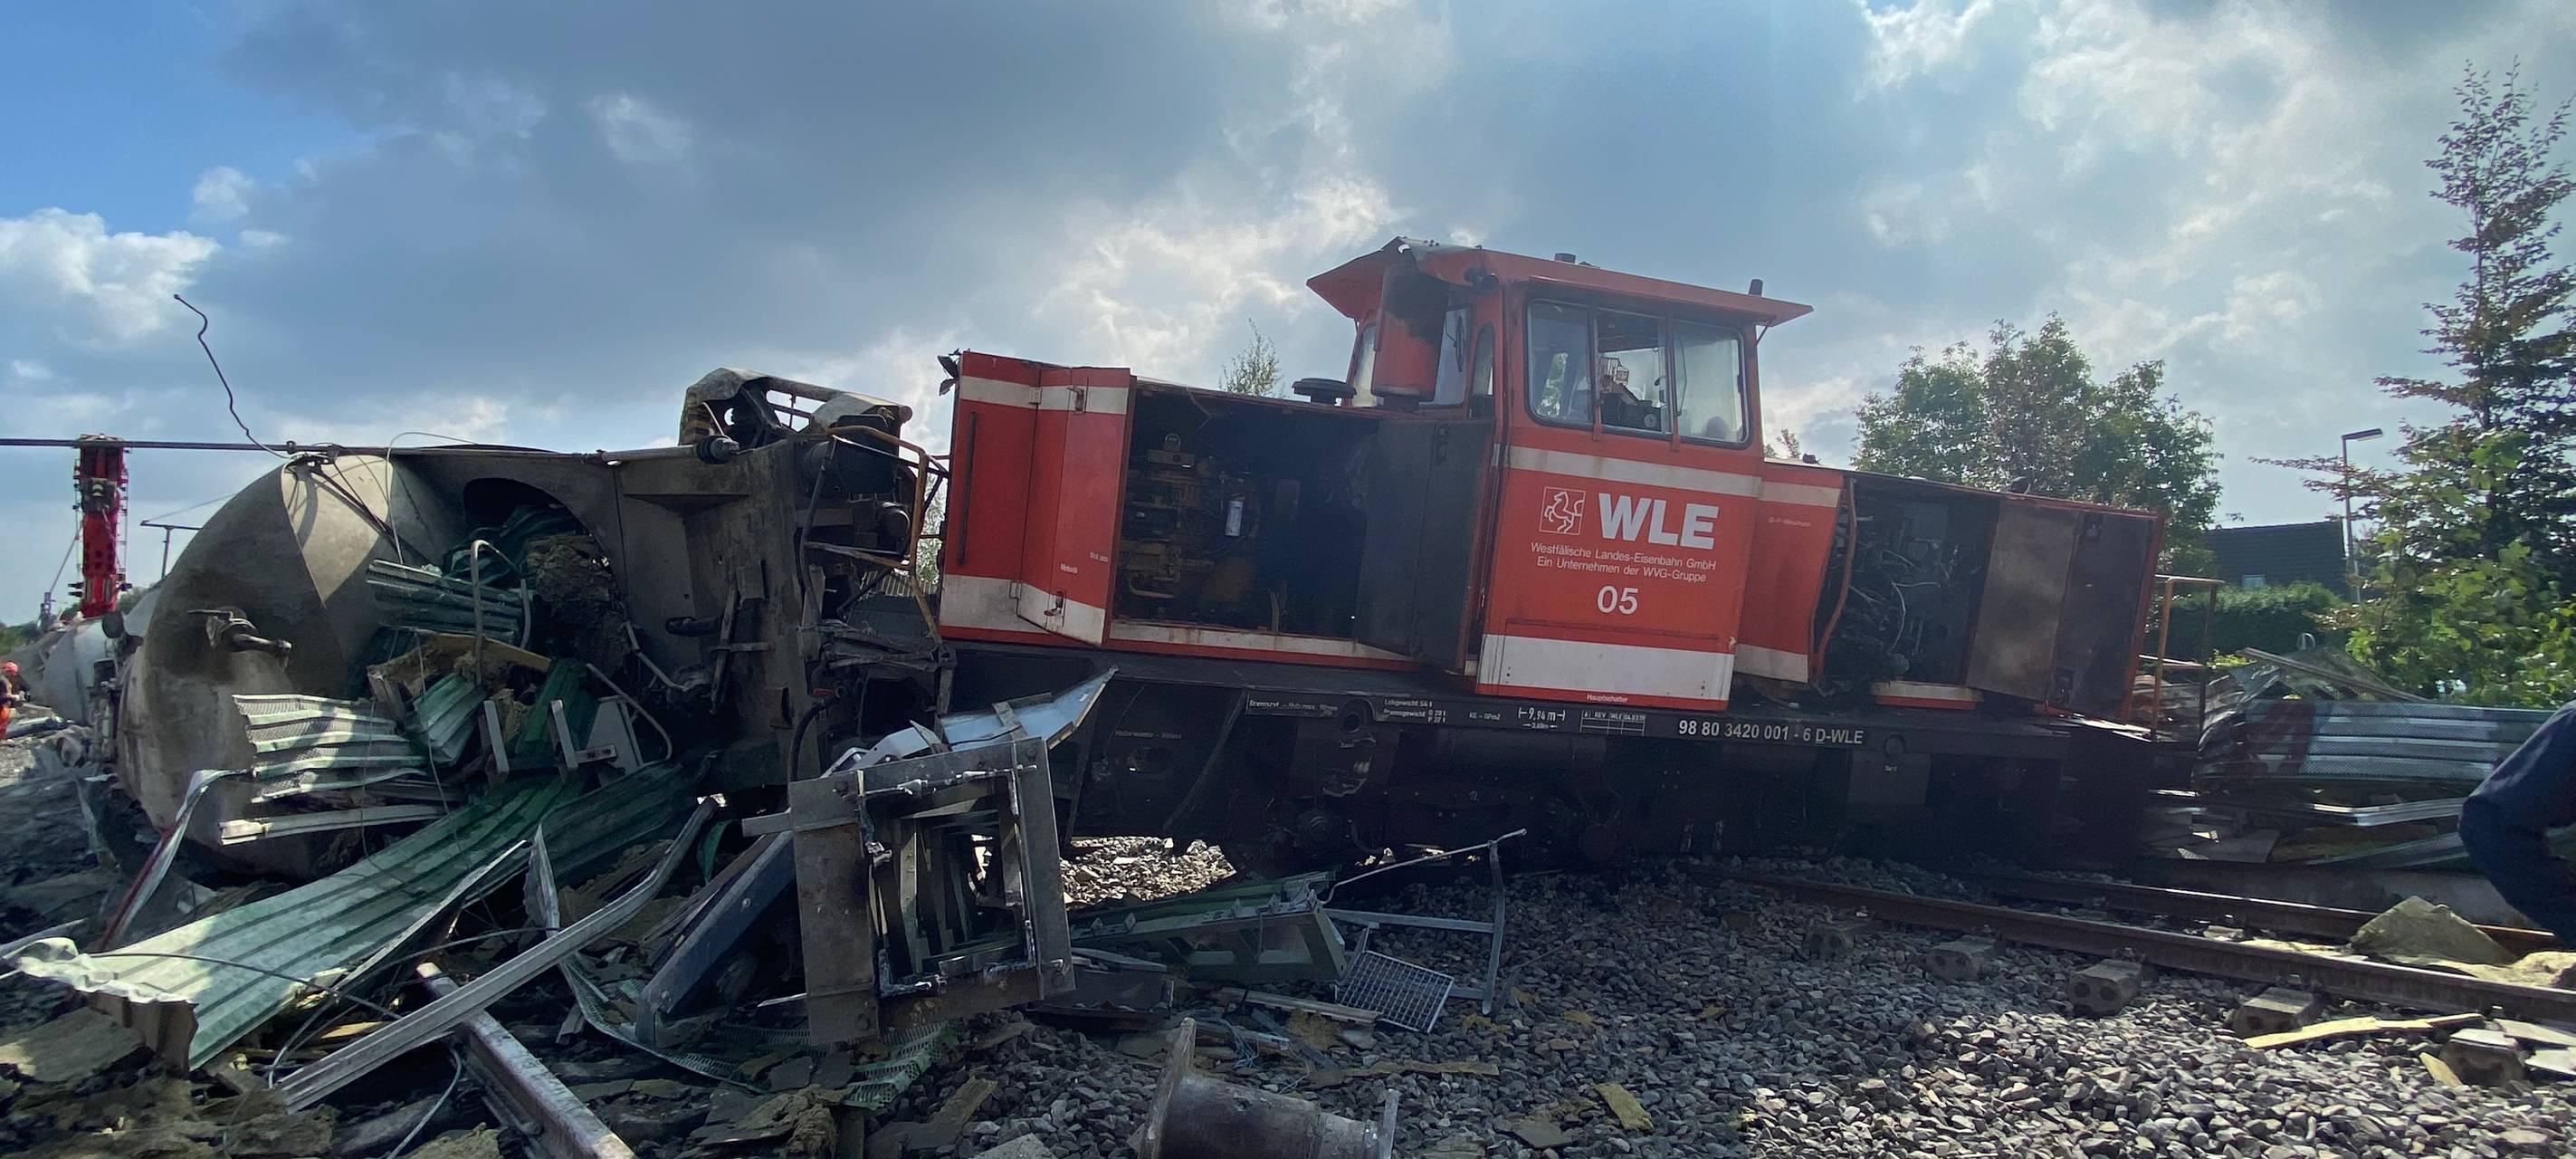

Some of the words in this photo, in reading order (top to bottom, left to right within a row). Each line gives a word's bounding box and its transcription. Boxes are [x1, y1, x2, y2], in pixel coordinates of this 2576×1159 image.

[1598, 492, 1719, 550] WLE
[1530, 541, 1592, 559] Westfälische
[1595, 549, 1684, 567] Landes-Eisenbahn
[1685, 558, 1717, 570] GmbH
[1537, 556, 1553, 567] Ein
[1556, 558, 1621, 574] Unternehmen
[1623, 563, 1639, 576] der
[1643, 566, 1707, 583] WVG-Gruppe
[1597, 585, 1639, 615] 05
[1587, 694, 1628, 704] Hauptschalter
[1547, 712, 1556, 722] m
[1678, 720, 1697, 735] 98
[1701, 721, 1720, 736] 80
[1723, 722, 1760, 739] 3420
[1764, 723, 1790, 741] 001
[1802, 726, 1811, 742] 6
[1815, 727, 1865, 745] D-WLE
